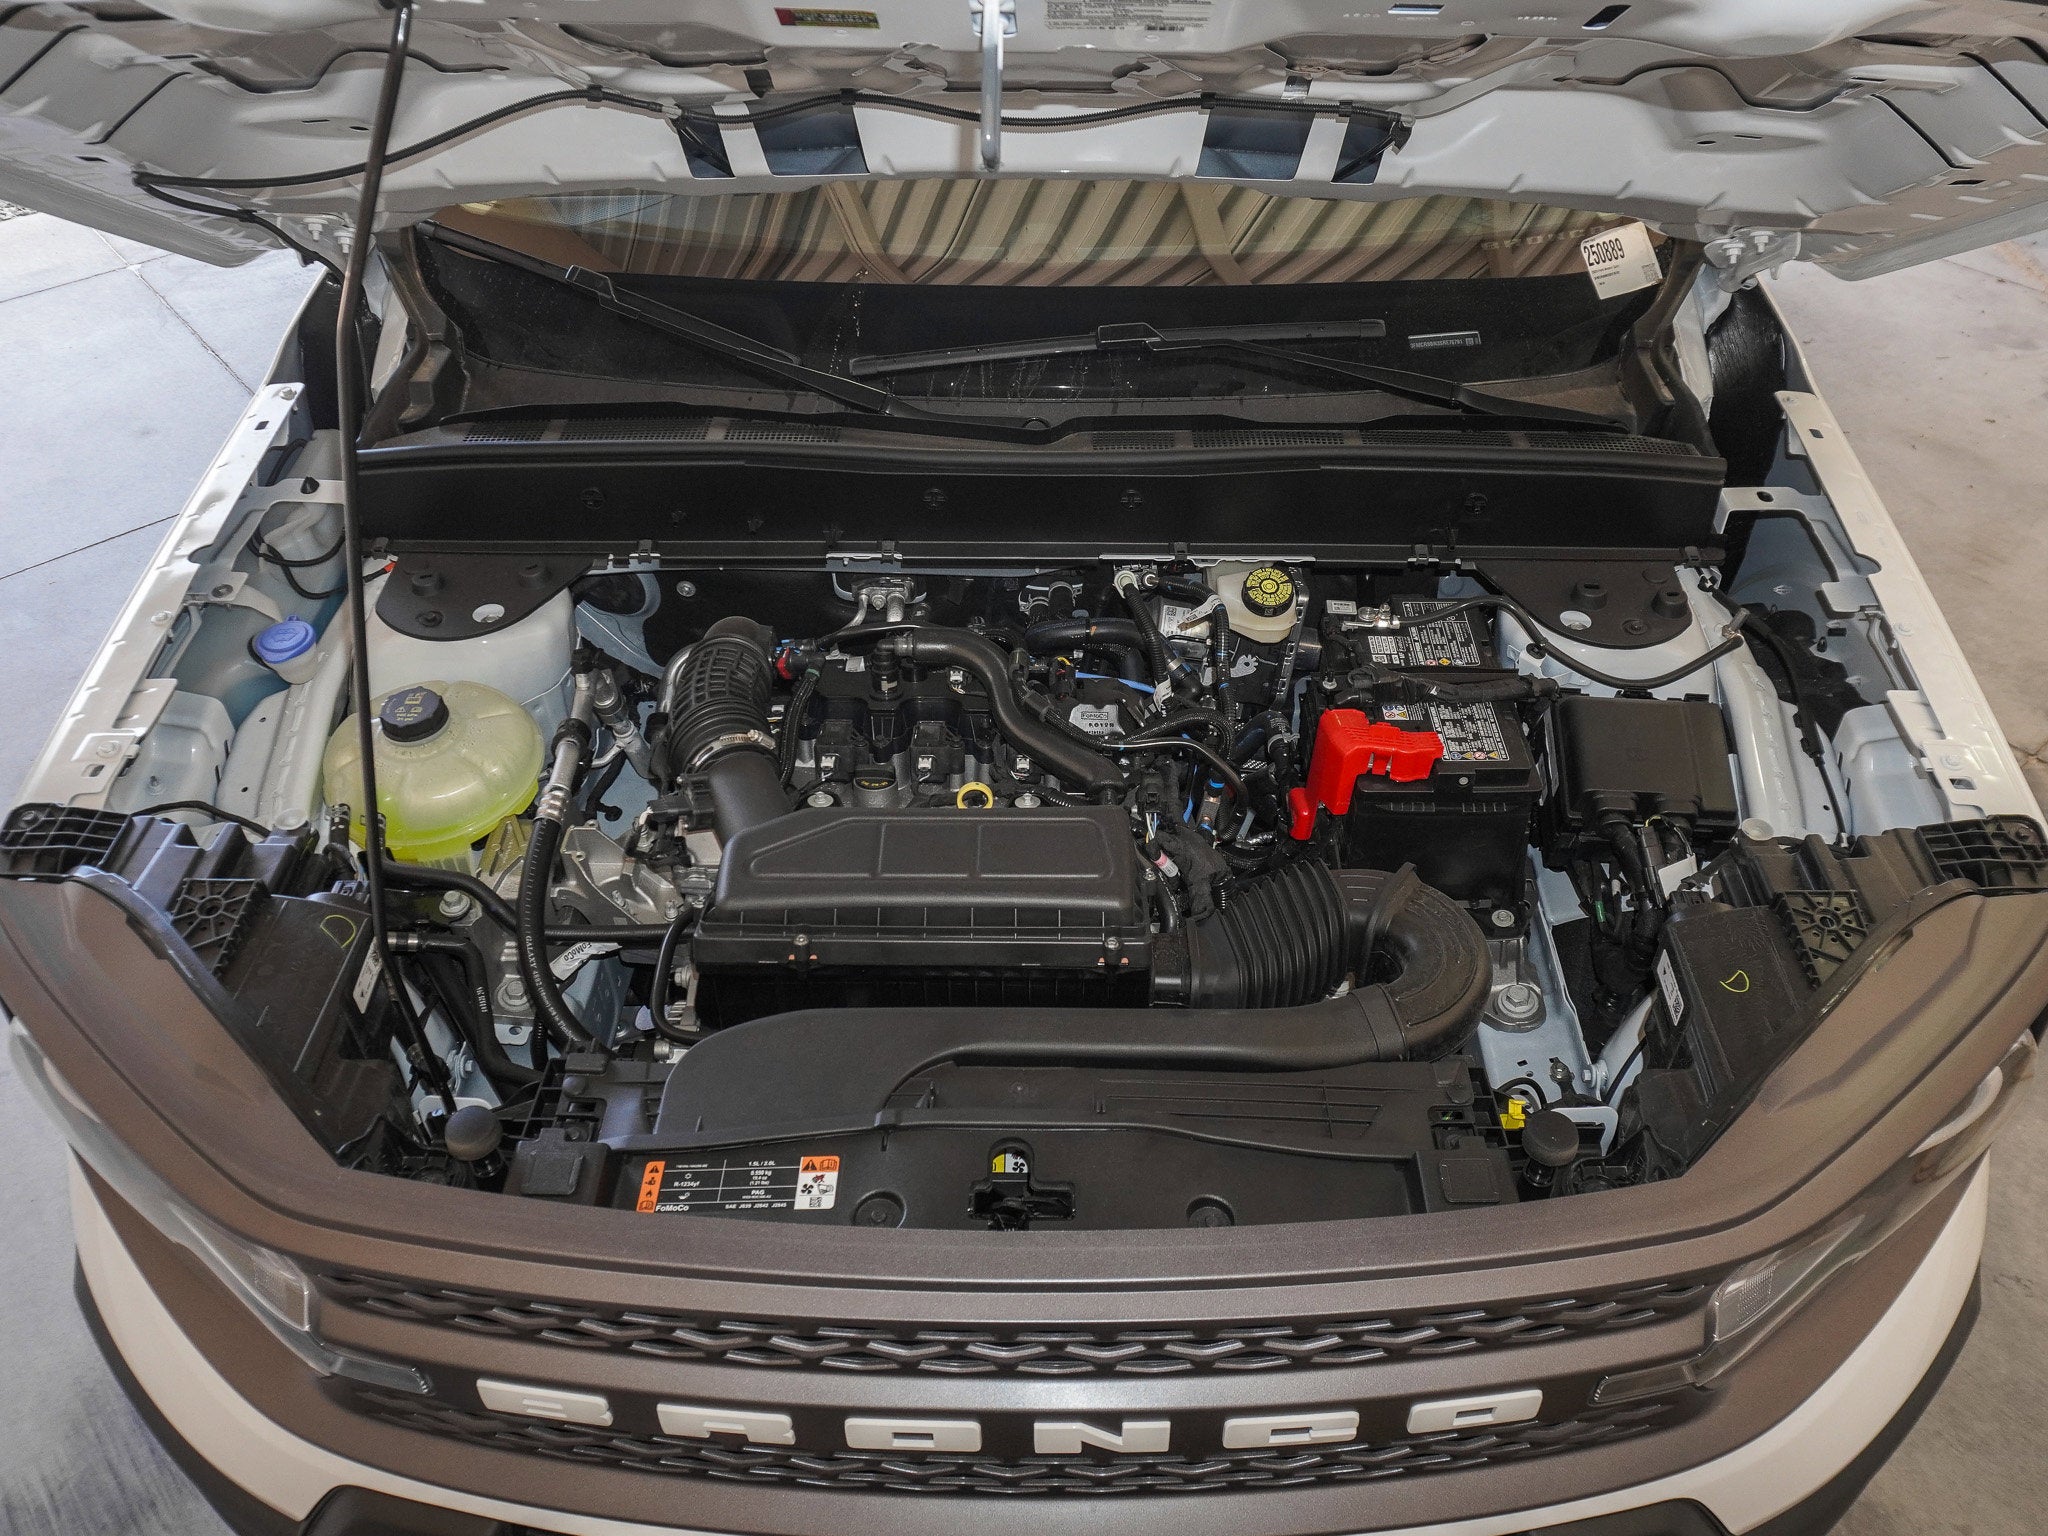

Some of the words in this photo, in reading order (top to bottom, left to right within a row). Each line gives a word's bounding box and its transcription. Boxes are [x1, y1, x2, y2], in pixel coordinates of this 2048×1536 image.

[1583, 237, 1625, 267] 250889
[526, 935, 537, 968] GALAXY
[655, 1204, 690, 1212] FoMoCo
[475, 1377, 1544, 1455] BRONCO
